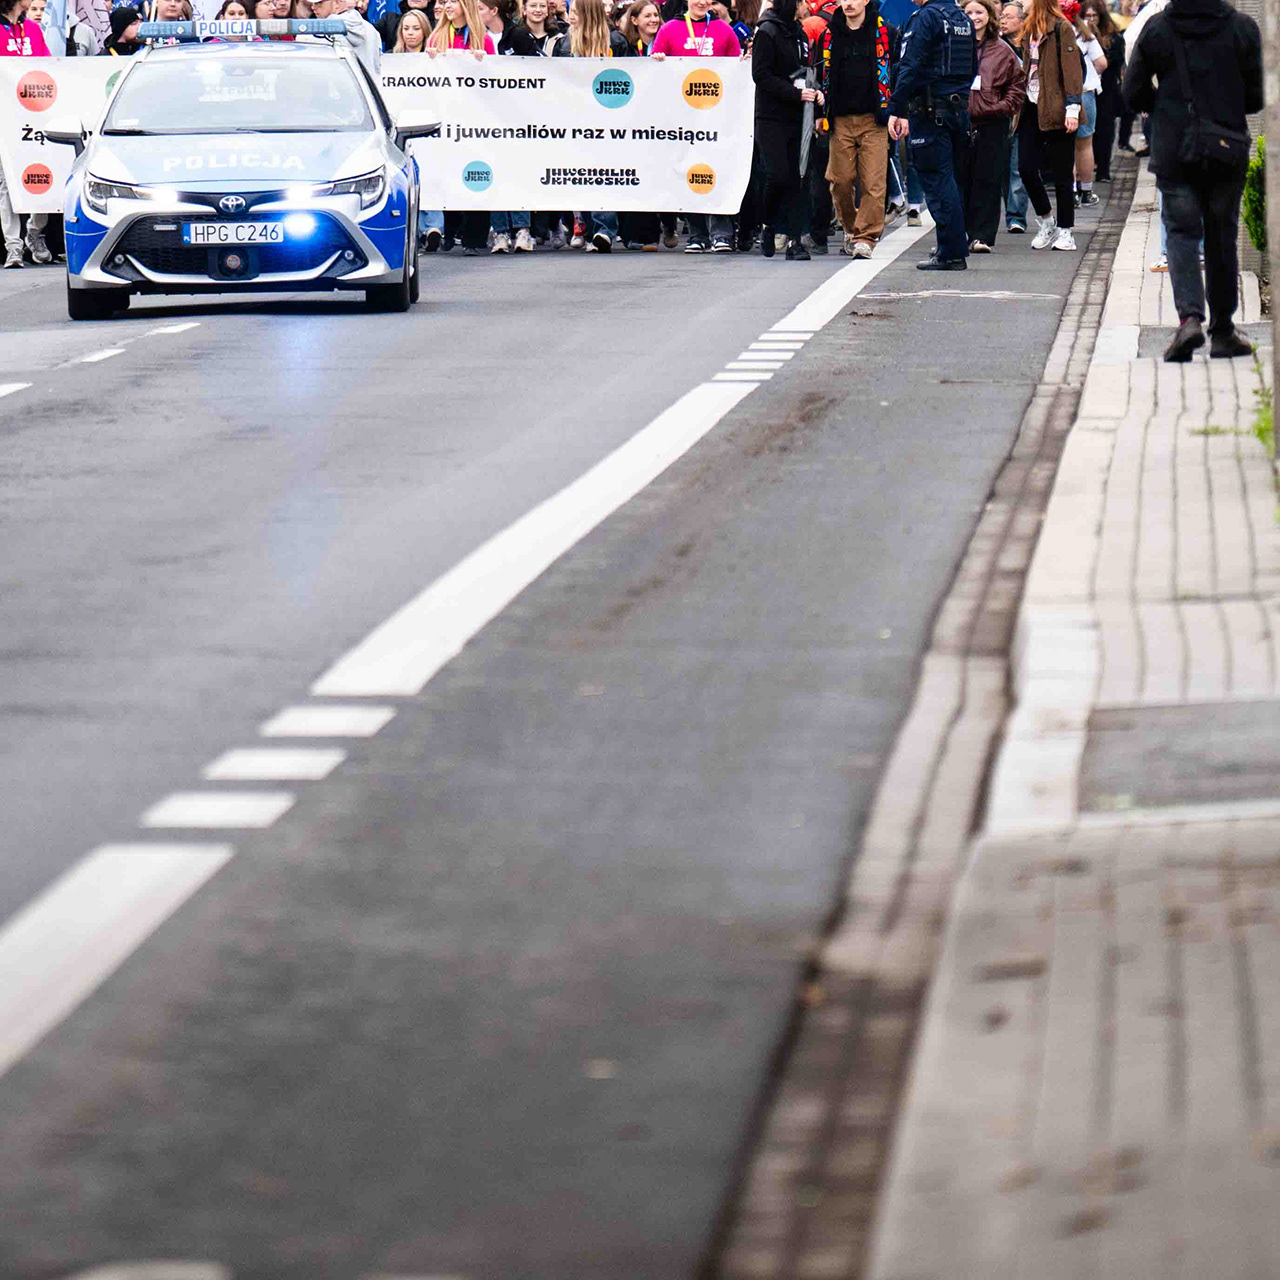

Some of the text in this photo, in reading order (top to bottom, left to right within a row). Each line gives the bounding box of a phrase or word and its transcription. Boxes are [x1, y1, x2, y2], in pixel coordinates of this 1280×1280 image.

[198, 21, 254, 35] POLICJA
[456, 76, 476, 88] TO
[478, 78, 546, 89] STUDENT
[446, 124, 451, 138] i
[454, 124, 567, 143] juwenaliów
[572, 127, 605, 139] raz
[610, 128, 627, 139] w
[631, 126, 718, 145] miesiącu
[163, 154, 306, 172] POLICJA
[194, 224, 279, 242] HPG C246
